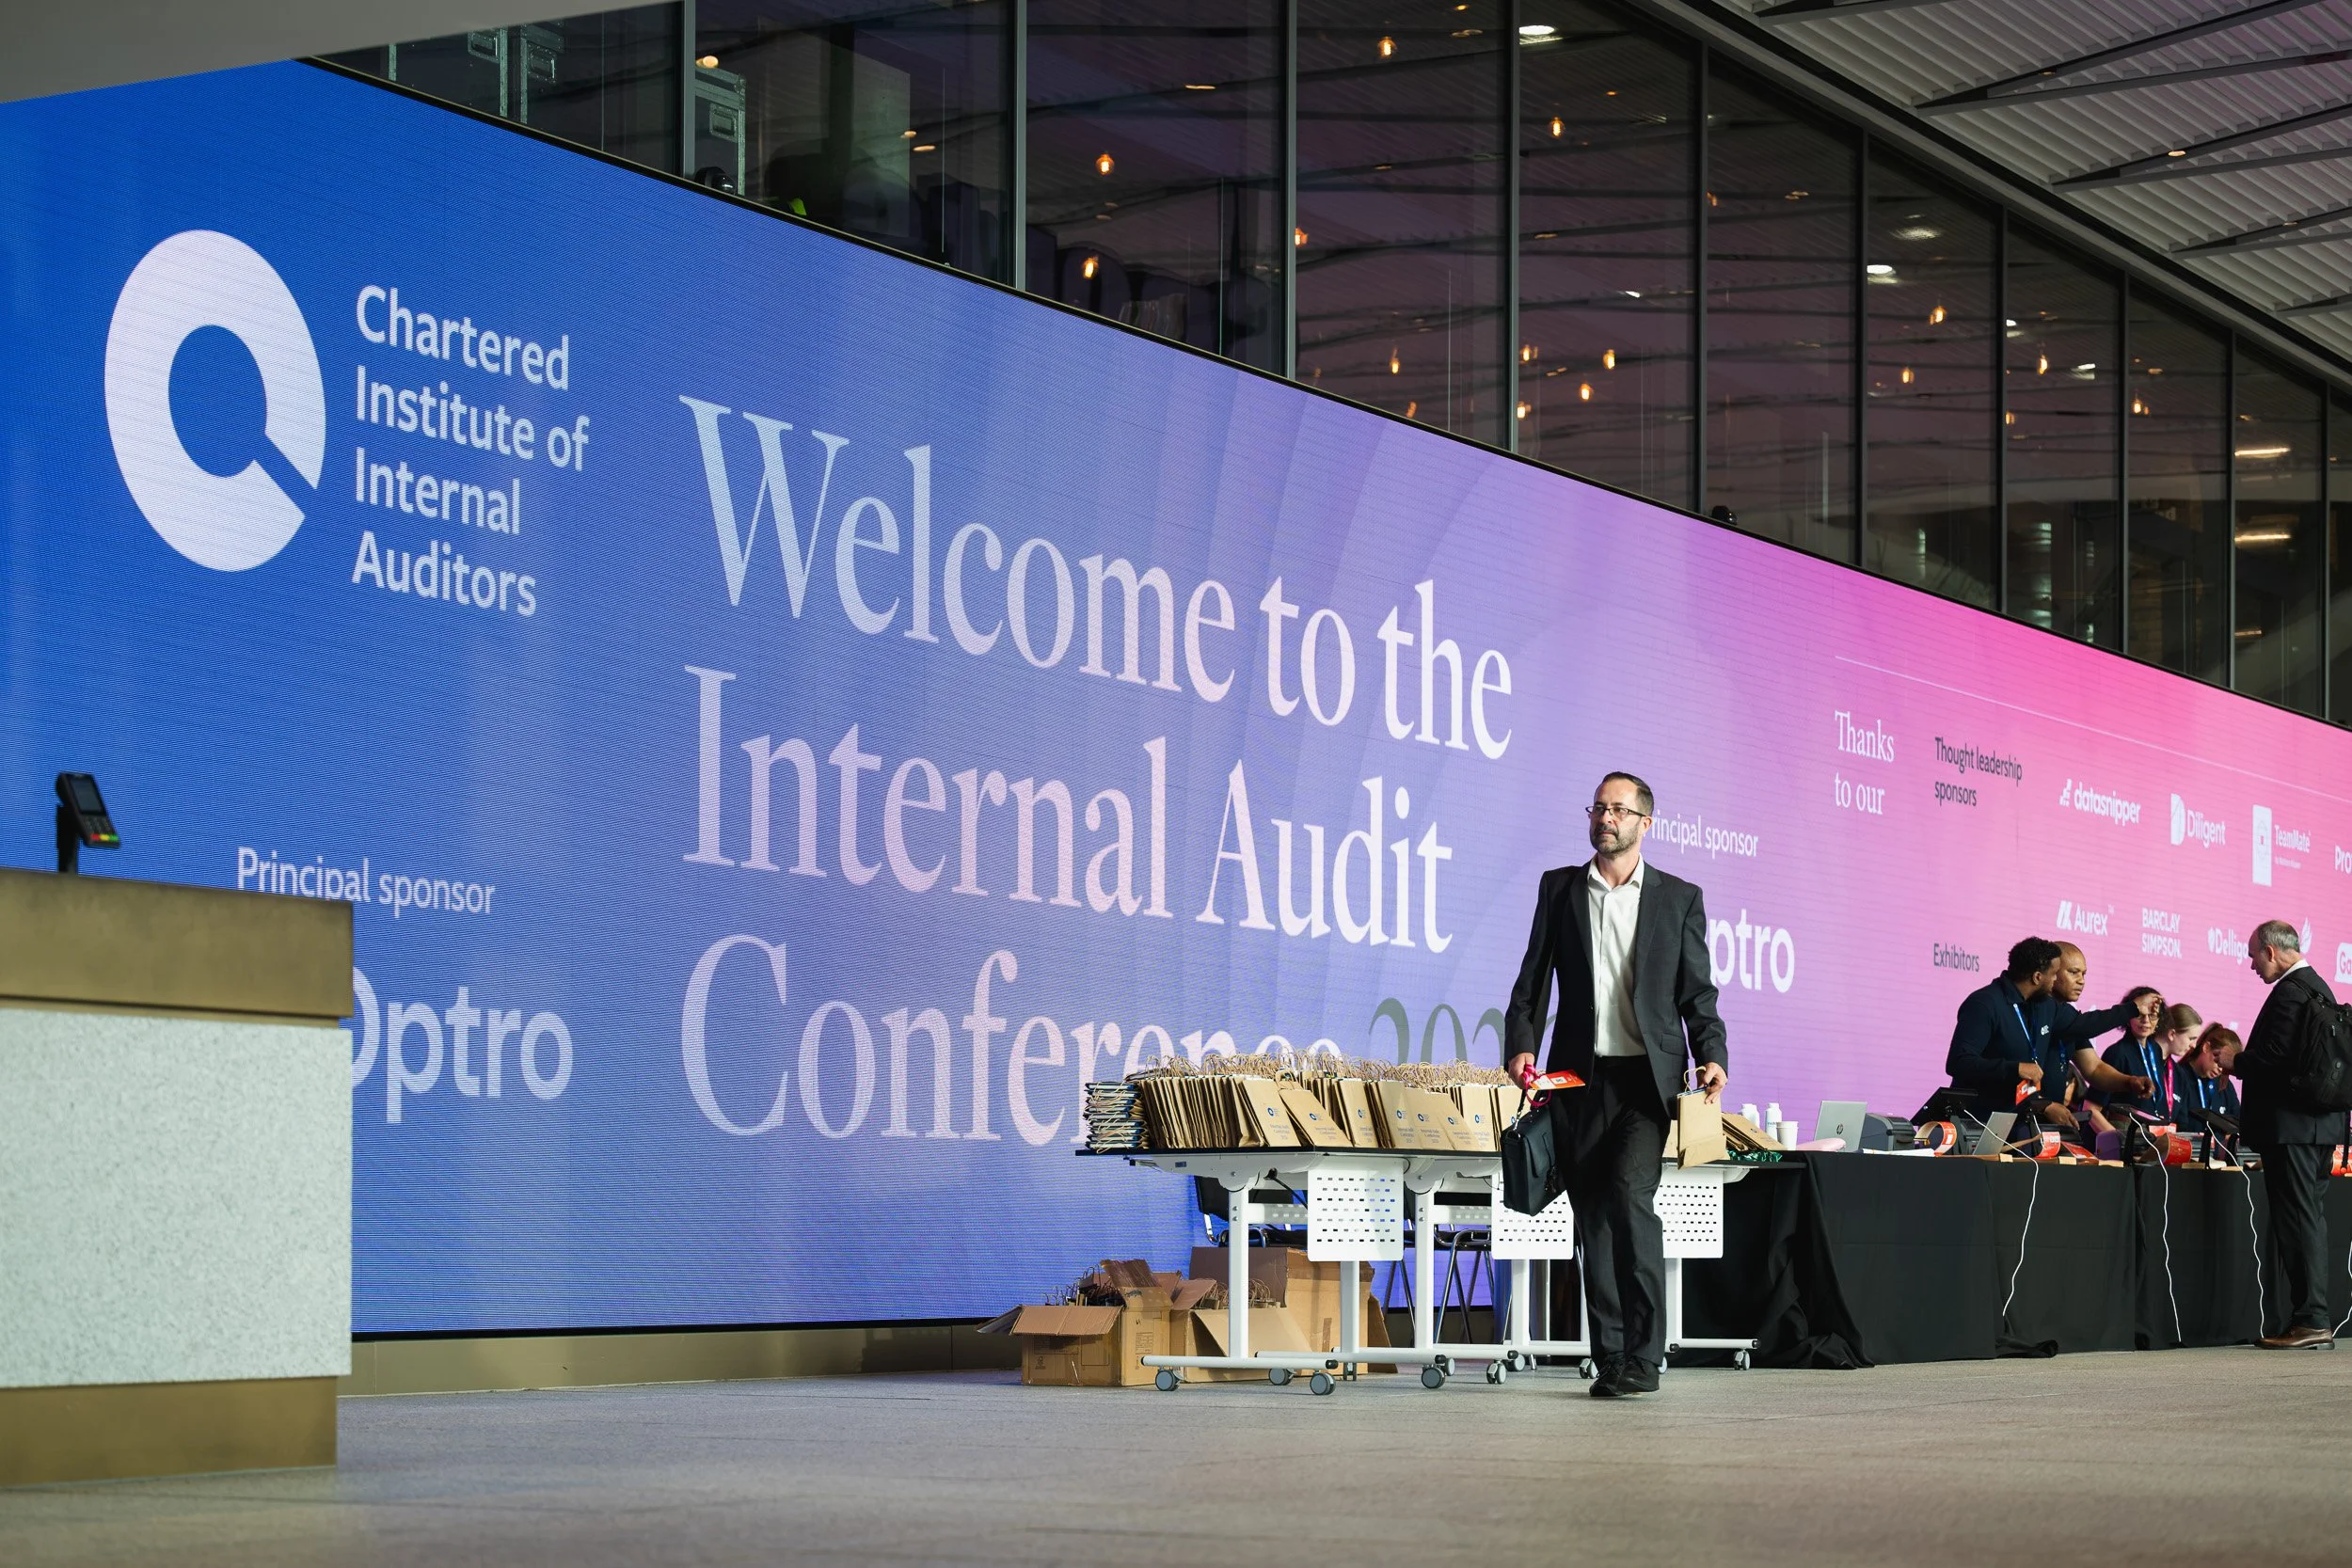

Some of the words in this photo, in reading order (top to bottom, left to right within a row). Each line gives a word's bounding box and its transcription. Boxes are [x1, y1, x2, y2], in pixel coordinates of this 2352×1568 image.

[356, 285, 569, 390] Chartered
[357, 365, 534, 460] Institute
[548, 416, 590, 471] of
[356, 447, 521, 534] Internal
[352, 530, 537, 617] Auditors
[679, 395, 1236, 704] Welcome
[1259, 575, 1355, 727] to
[1377, 579, 1513, 760] the
[1835, 709, 1895, 764] Thanks
[1934, 736, 1974, 773] Thought
[1976, 746, 2022, 787] leadership
[683, 664, 1173, 920] Internal
[1196, 758, 1454, 954] Audit
[1835, 771, 1851, 808] to
[1856, 783, 1885, 816] our
[1934, 780, 1977, 806] sponsors
[2074, 781, 2141, 827] datasnipper
[1643, 809, 1702, 854] rincipal
[1705, 826, 1758, 860] sponsor
[2187, 810, 2226, 847] Diligent
[378, 874, 495, 918] sponsor
[2141, 908, 2181, 934] BARCLAY
[1708, 909, 1795, 993] ptro
[1933, 942, 1979, 973] Exhibitors
